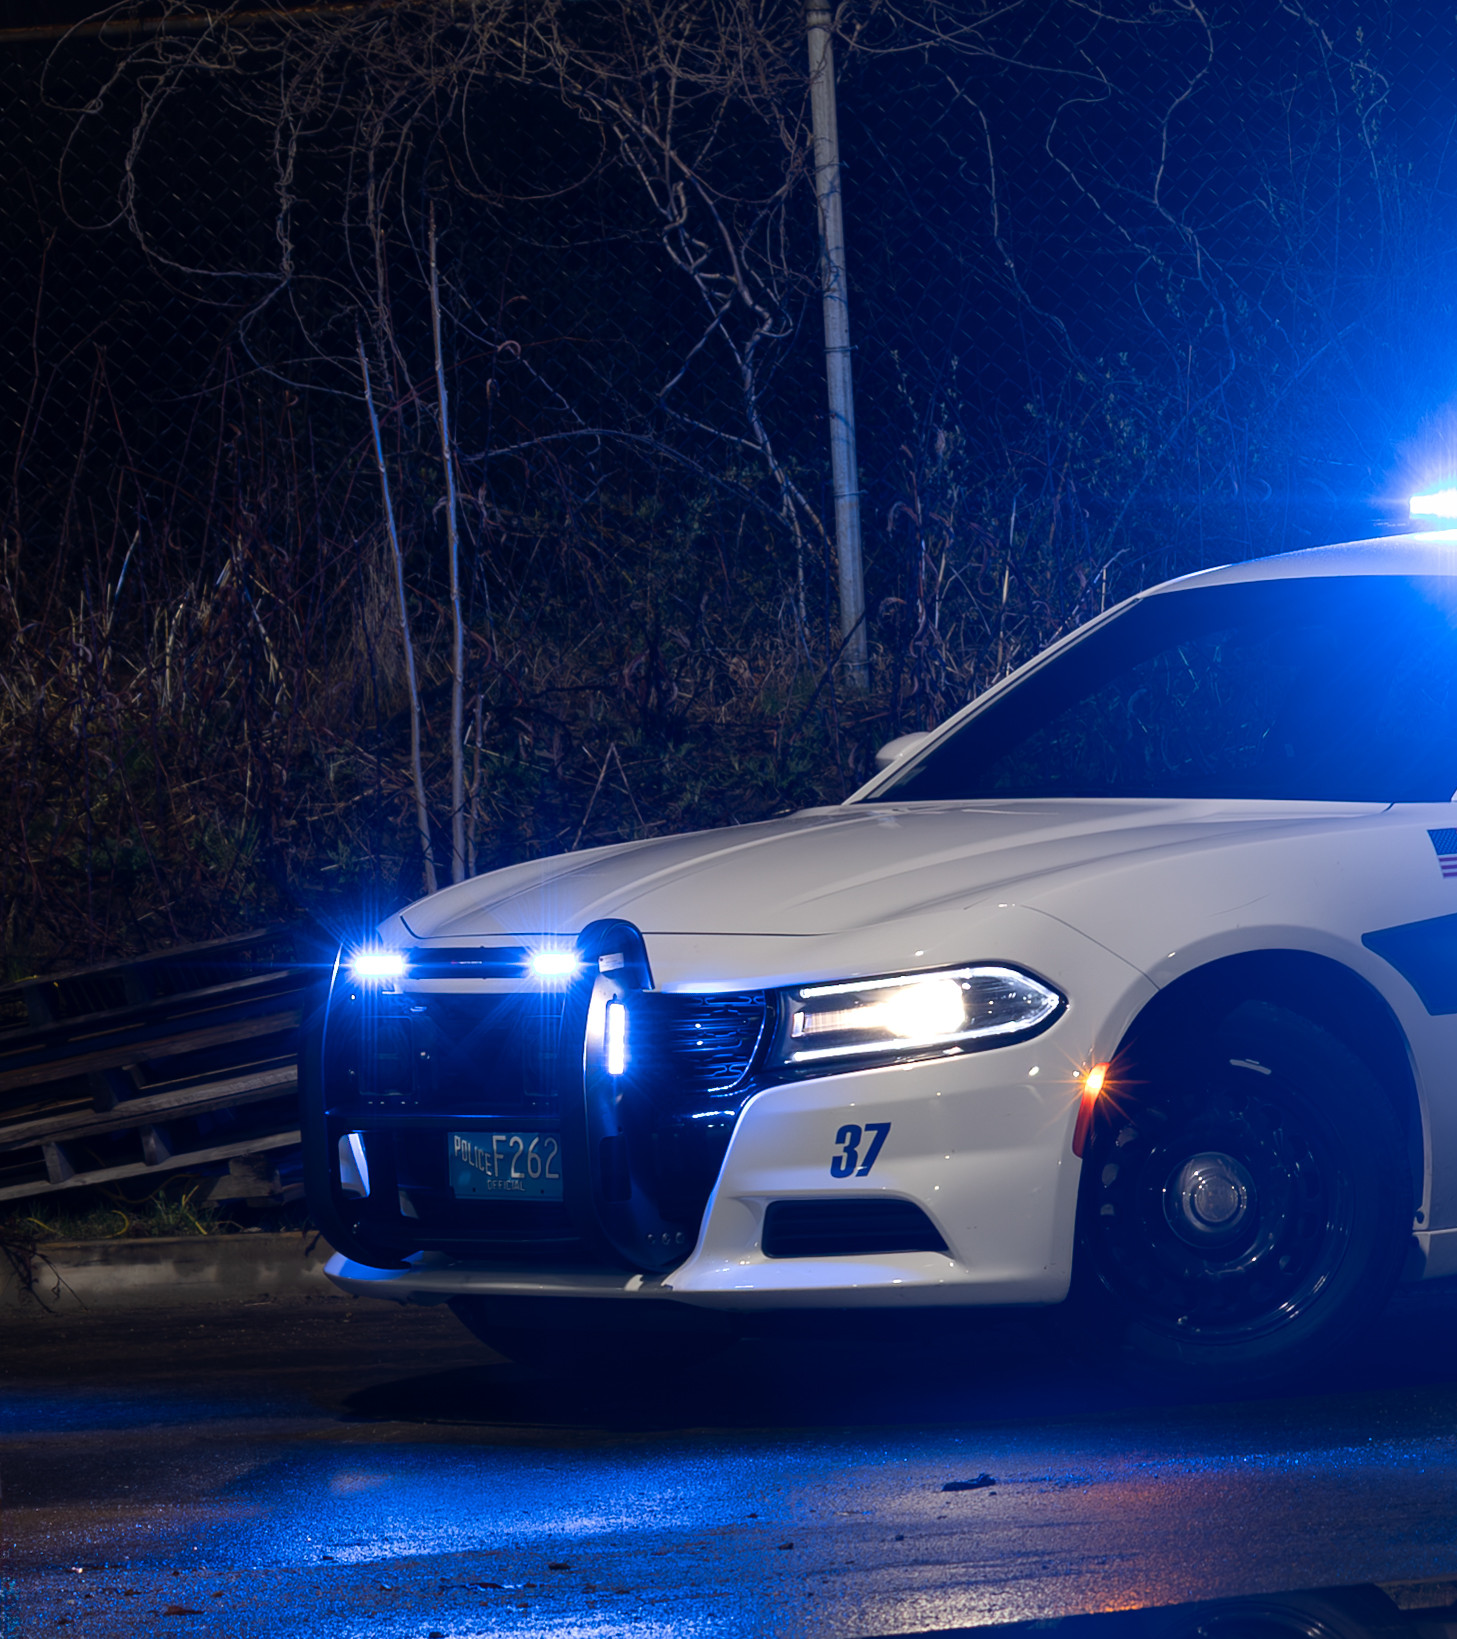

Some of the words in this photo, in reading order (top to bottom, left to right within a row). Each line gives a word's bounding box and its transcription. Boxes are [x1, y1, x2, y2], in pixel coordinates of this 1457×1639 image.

[454, 1135, 492, 1176] POLICE
[493, 1135, 560, 1178] F262
[830, 1122, 892, 1178] 37
[487, 1179, 526, 1191] OFFICIAL
